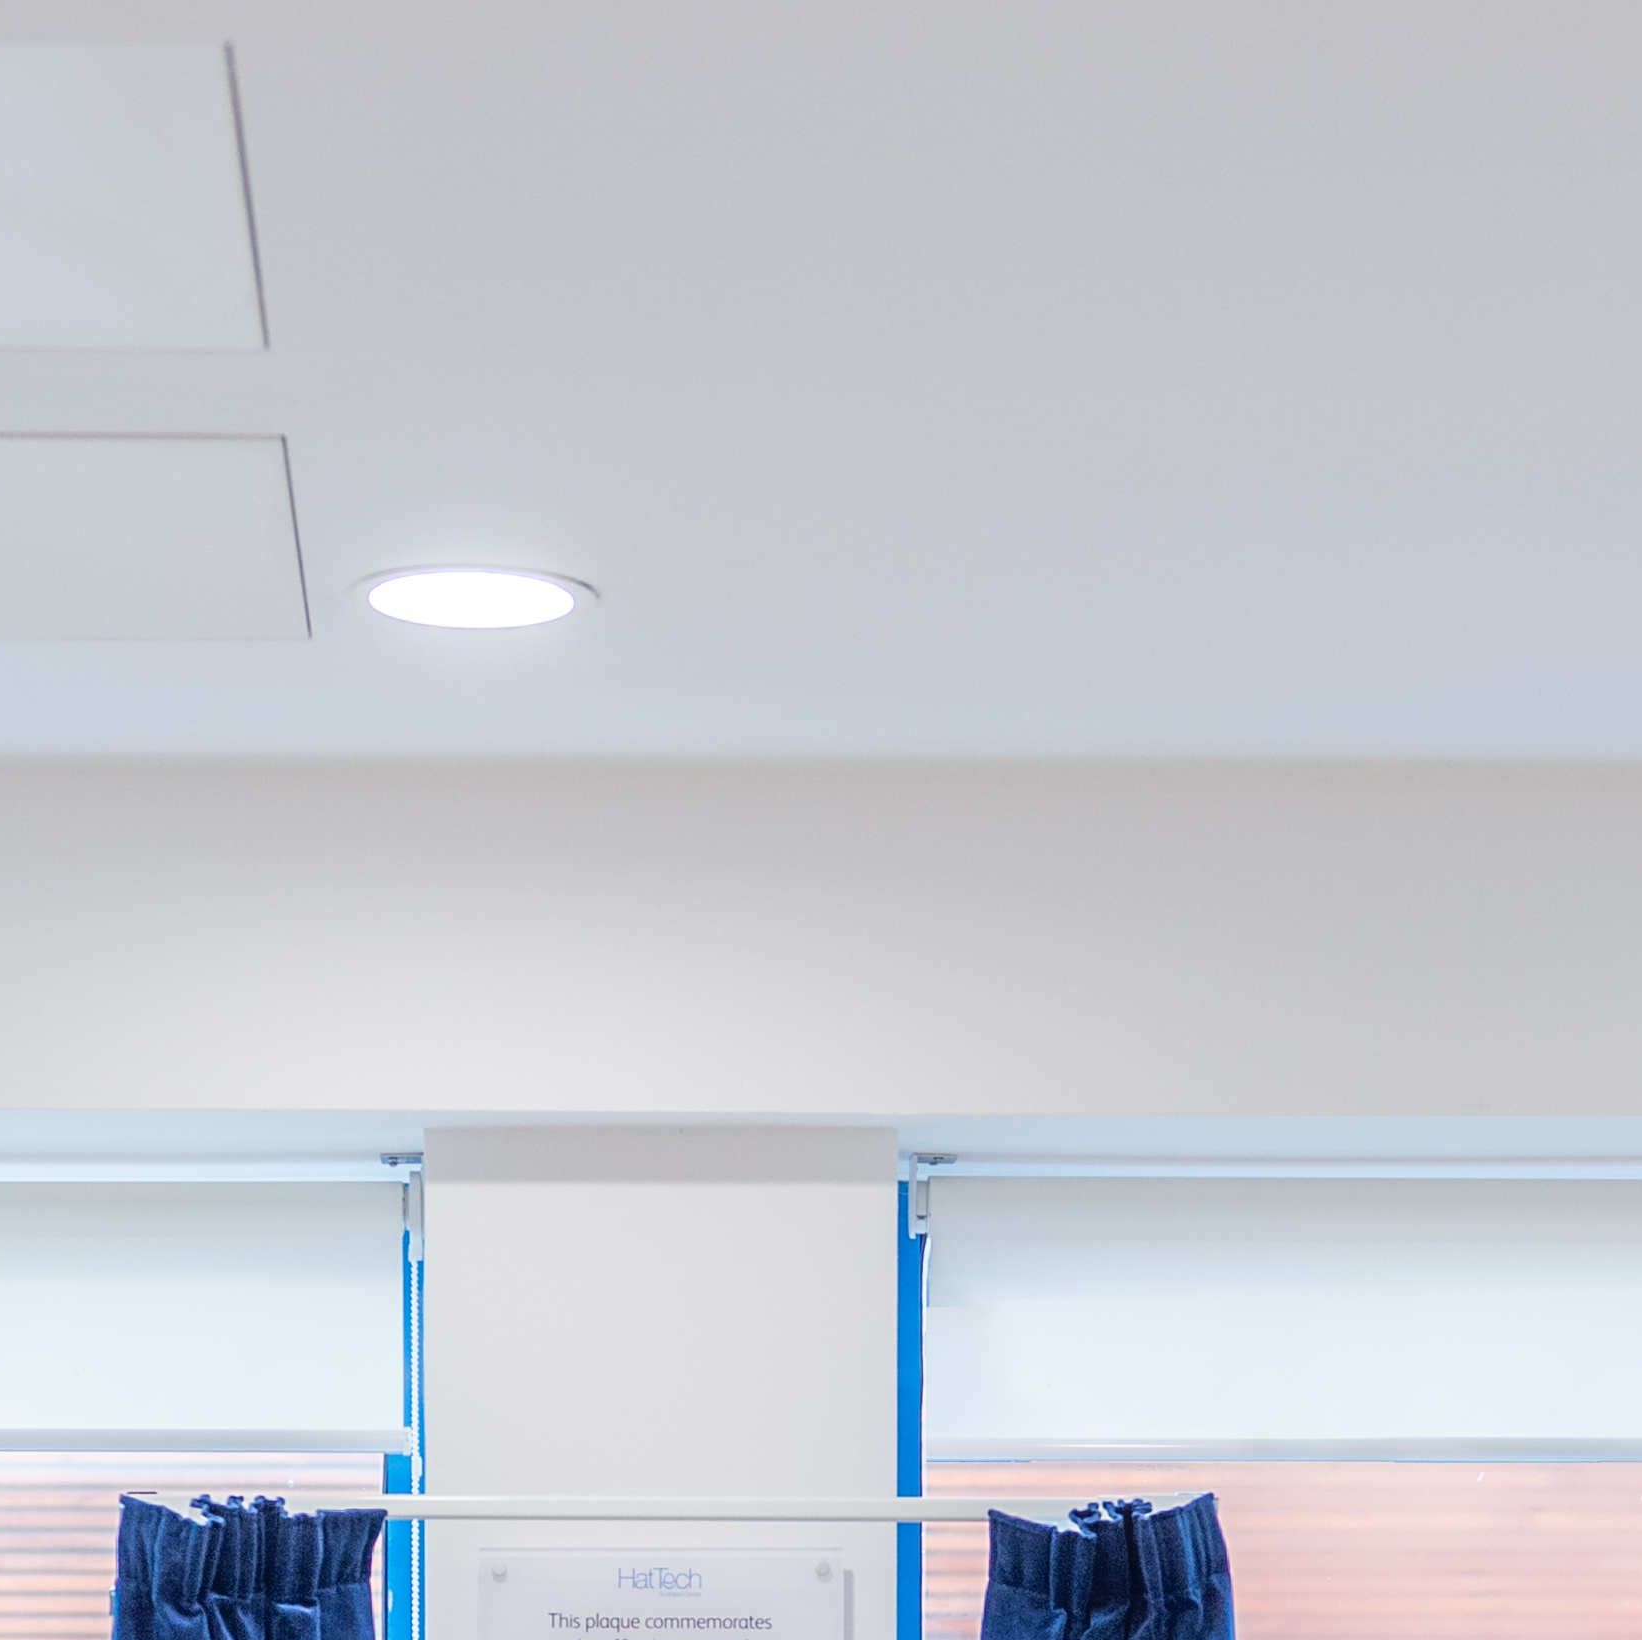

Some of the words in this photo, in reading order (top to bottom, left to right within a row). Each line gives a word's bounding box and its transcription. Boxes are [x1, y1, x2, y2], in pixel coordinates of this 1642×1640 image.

[617, 1566, 703, 1590] HatTech
[547, 1612, 581, 1629] This
[585, 1612, 641, 1634] plaque
[644, 1615, 773, 1630] commemorates
